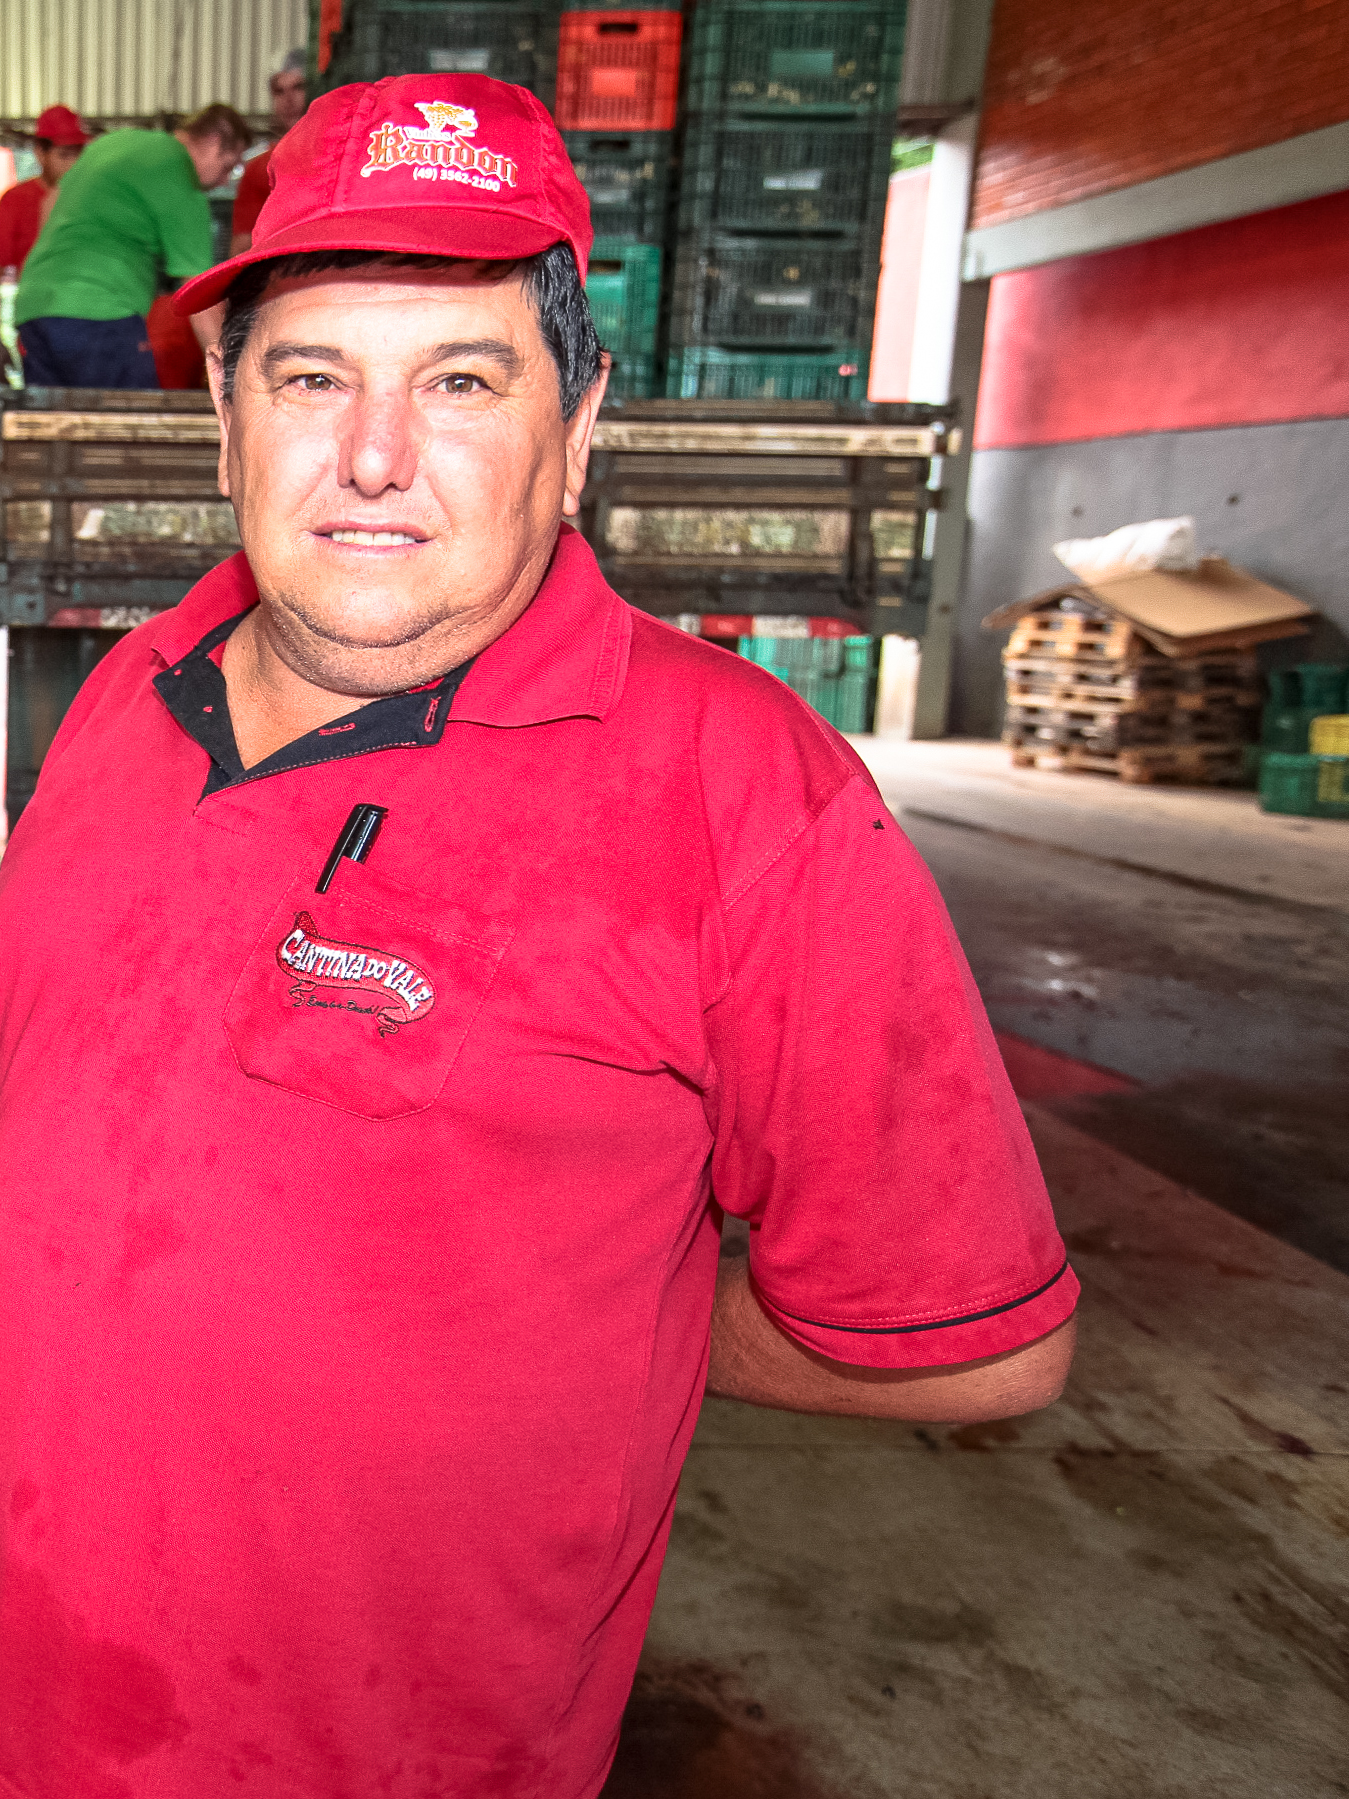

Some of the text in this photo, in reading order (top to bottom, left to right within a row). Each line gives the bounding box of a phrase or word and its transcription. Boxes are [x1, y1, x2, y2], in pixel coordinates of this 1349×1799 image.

[413, 166, 500, 192] (49) 3562-2100
[281, 929, 432, 1012] CANTINA DO VALE
